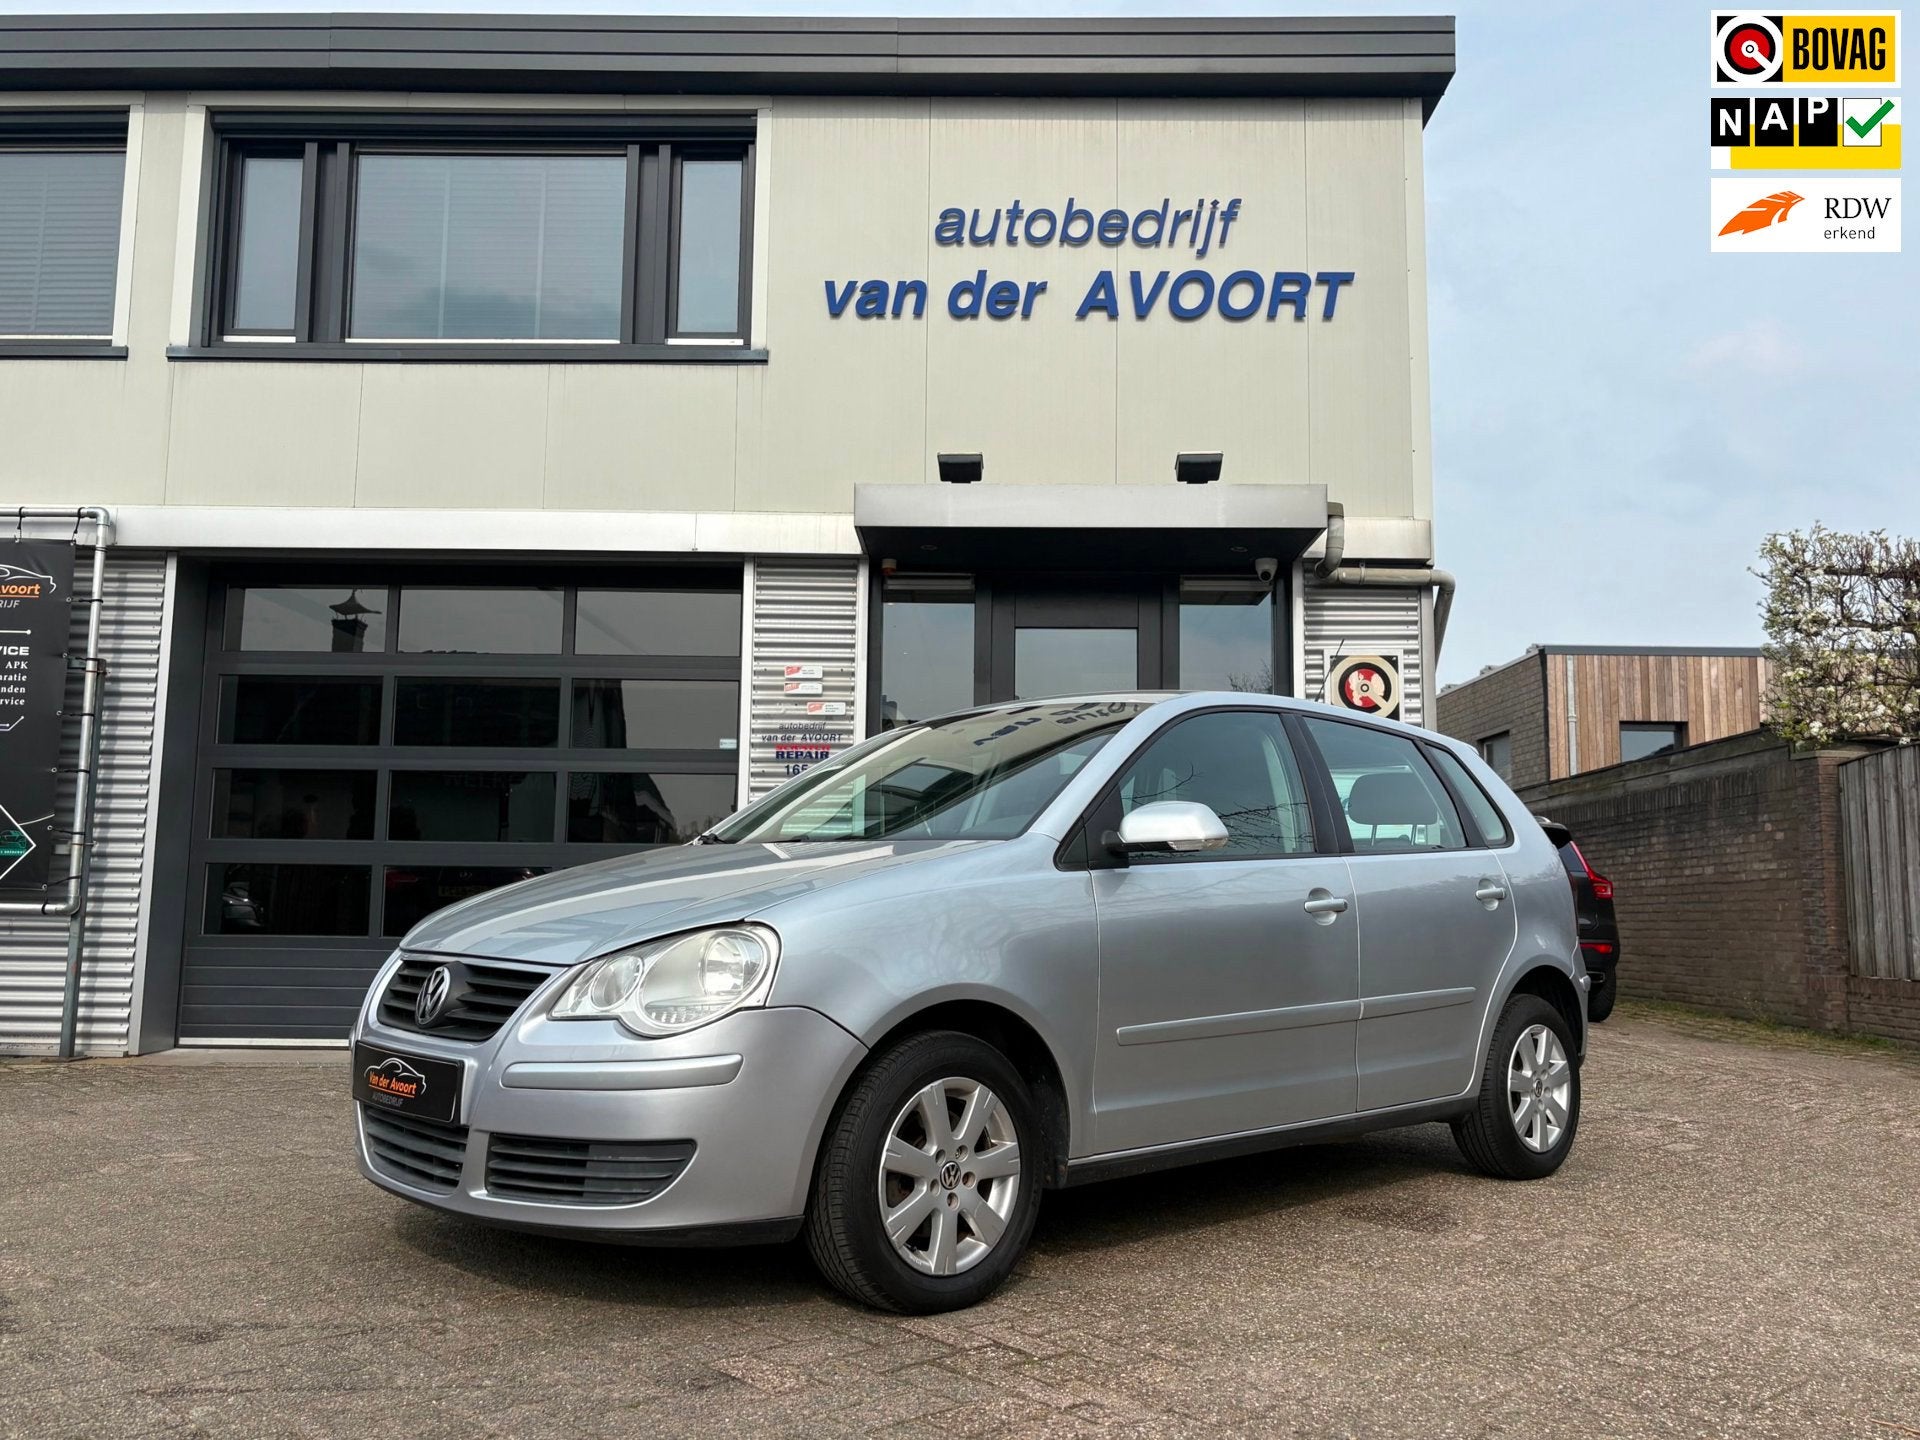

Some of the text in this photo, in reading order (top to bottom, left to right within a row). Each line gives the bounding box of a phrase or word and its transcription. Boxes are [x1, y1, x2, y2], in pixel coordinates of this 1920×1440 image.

[935, 197, 1242, 257] autobedrijf
[824, 269, 1356, 321] van der AVOORT
[0, 583, 41, 595] voort
[5, 660, 29, 670] APK
[779, 722, 826, 731] autobedrijf
[761, 733, 843, 742] van der AVOORT
[775, 750, 830, 760] REPAIR
[379, 1074, 390, 1088] der
[390, 1077, 417, 1095] Avoort
